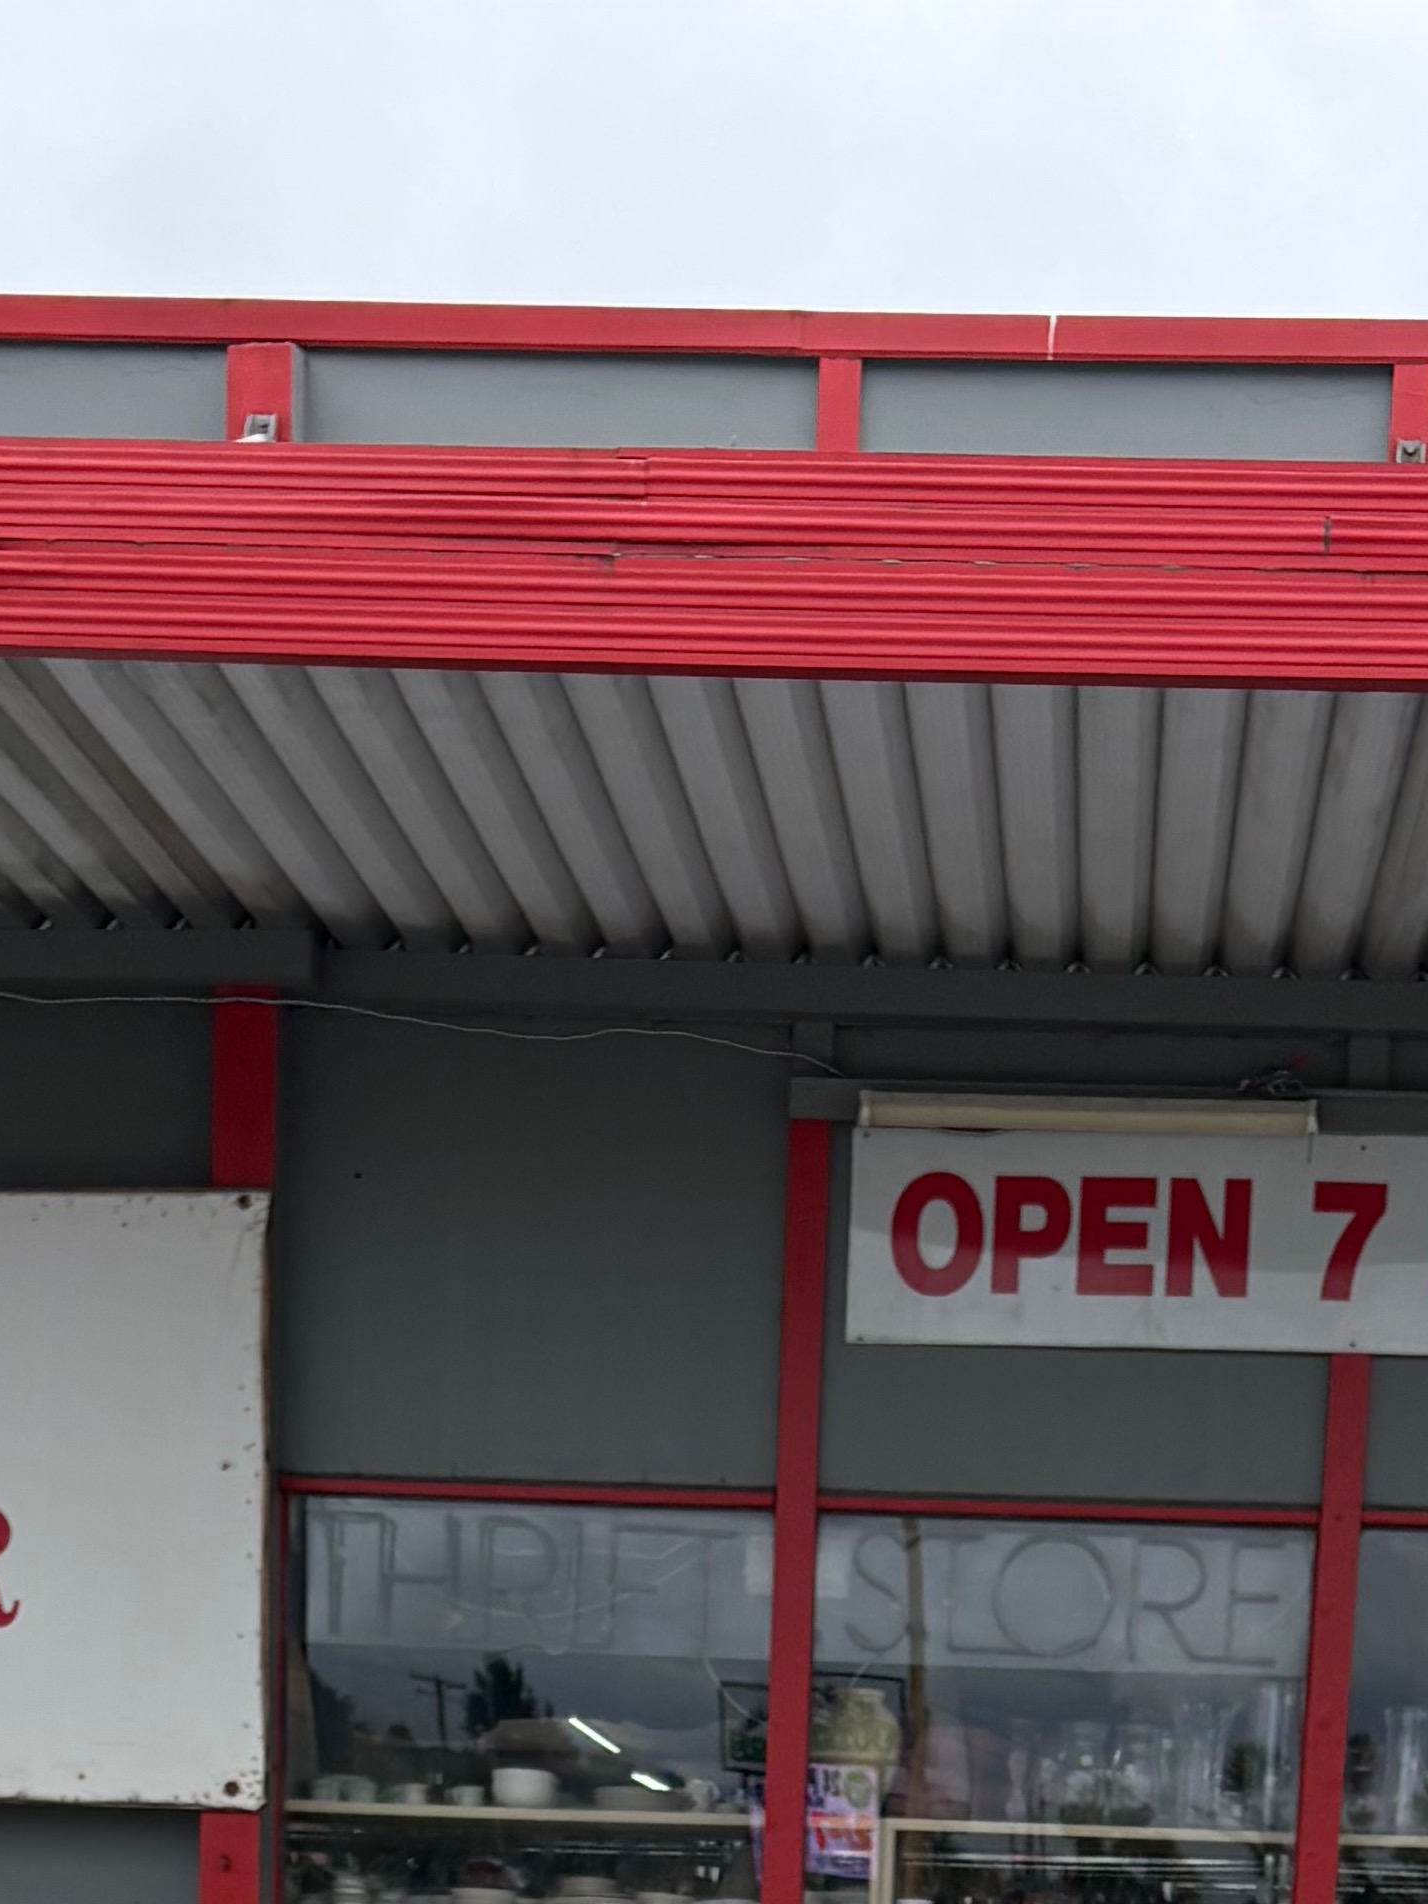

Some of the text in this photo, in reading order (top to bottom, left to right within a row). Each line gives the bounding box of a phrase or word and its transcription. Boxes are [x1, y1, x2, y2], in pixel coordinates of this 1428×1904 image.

[890, 1171, 1253, 1299] OPEN
[1314, 1180, 1387, 1301] 7
[318, 1509, 1287, 1669] THRIFT STORE
